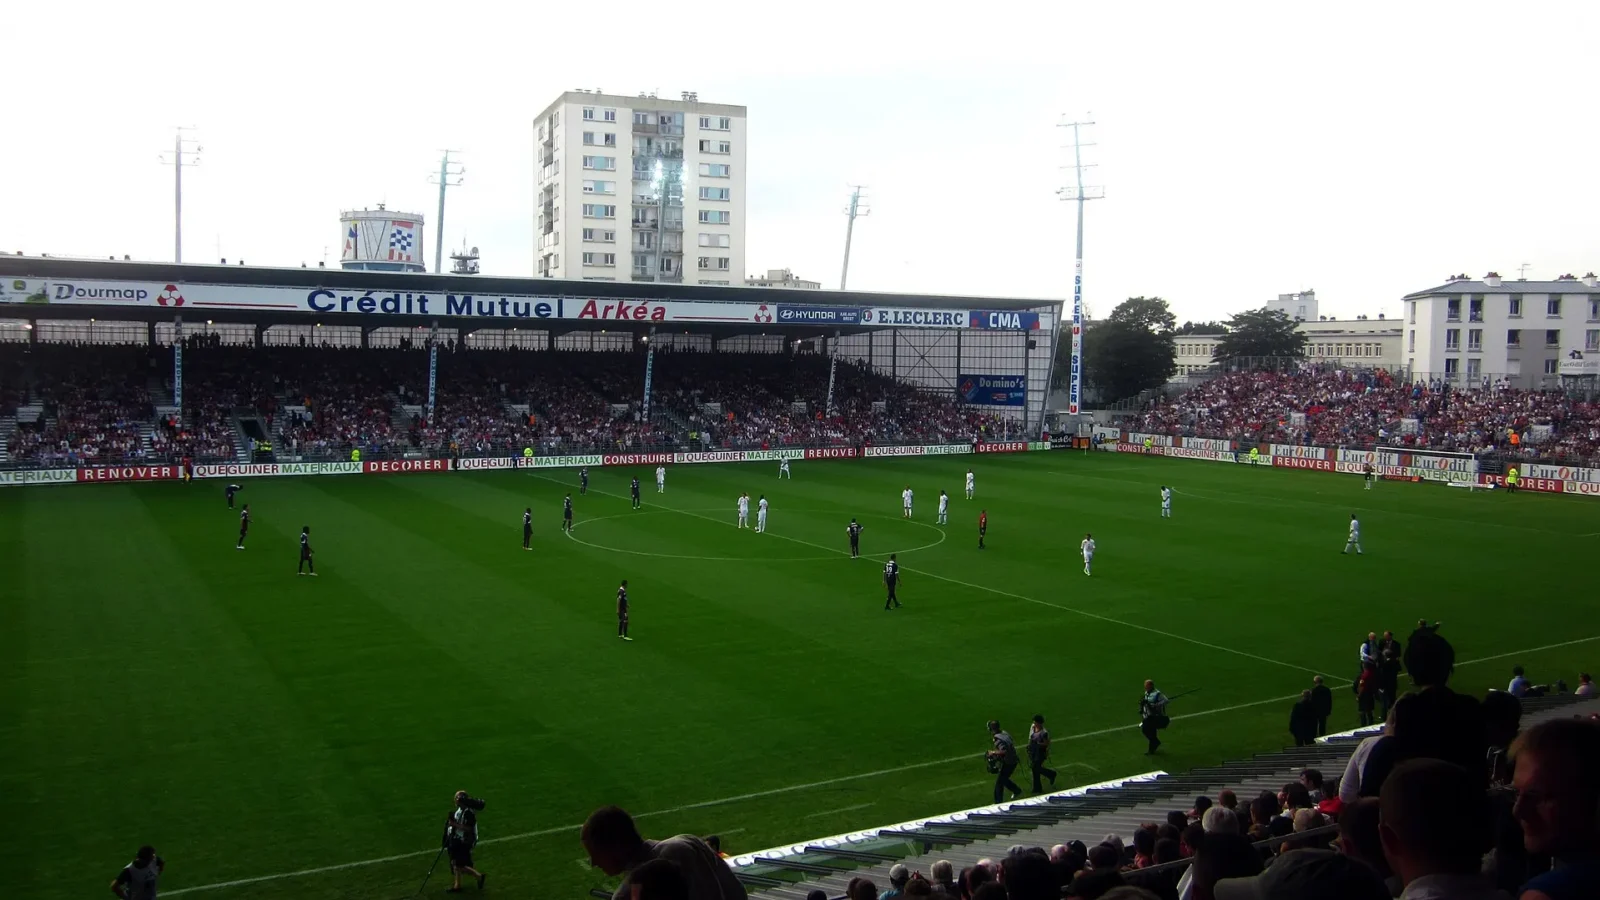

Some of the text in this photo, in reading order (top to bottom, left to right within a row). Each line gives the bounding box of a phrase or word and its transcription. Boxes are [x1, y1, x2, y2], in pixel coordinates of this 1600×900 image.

[53, 283, 148, 301] Dourmap
[307, 289, 667, 321] Crédit Mutuel Arkéa
[1072, 275, 1081, 335] SUPER U
[795, 310, 836, 320] HYUNDAI
[878, 310, 964, 326] E.LECLERC
[988, 312, 1022, 329] CMA
[979, 376, 1024, 389] Domino's
[1069, 355, 1079, 414] SUPER U
[979, 442, 1023, 452] DECORER
[1132, 434, 1168, 446] EuOdif
[686, 449, 803, 463] QUEGUINER MATERIAUX
[808, 449, 858, 458] RENOVE
[875, 445, 974, 456] QUEGUINER MATERIAUX
[1173, 447, 1271, 465] QUEGUINER MAERUX
[370, 459, 442, 472] DECORER
[534, 455, 601, 467] MATERIAUX
[603, 453, 673, 465] CONSTRUIRE
[1277, 457, 1331, 471] RENOVER
[84, 466, 172, 480] RENOVER
[196, 462, 361, 477] QUEGUINER MATERIAUX
[1347, 461, 1476, 483] QUEUINER MATERIAUX
